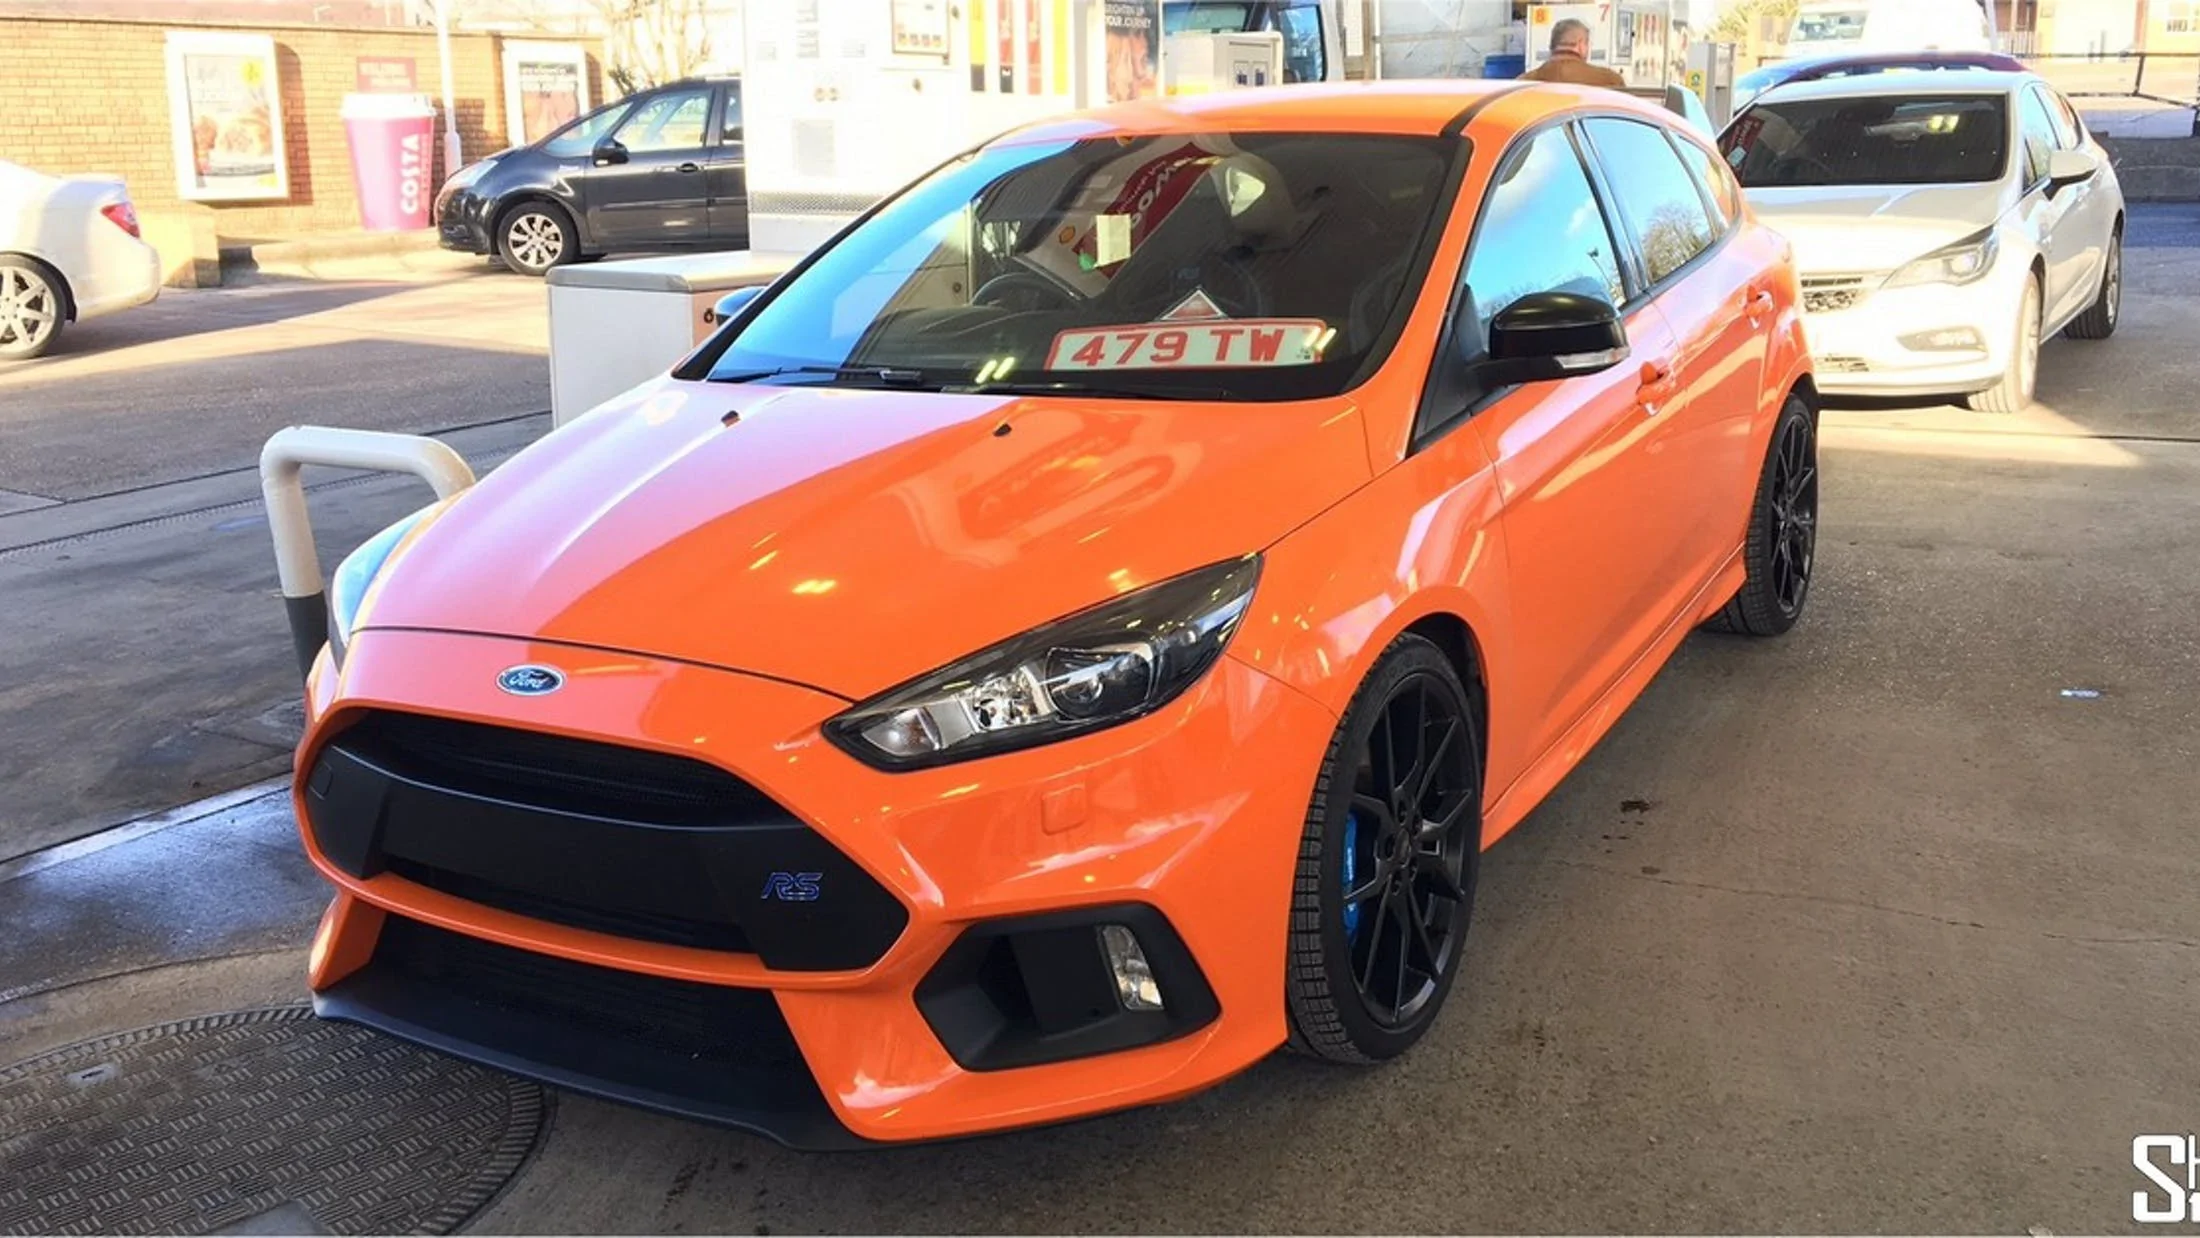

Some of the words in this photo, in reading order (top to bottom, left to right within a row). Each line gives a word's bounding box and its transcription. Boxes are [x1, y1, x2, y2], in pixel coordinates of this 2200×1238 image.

[1600, 4, 1611, 21] 7
[400, 133, 420, 215] COSTA
[1070, 331, 1189, 367] 479
[1209, 328, 1285, 362] TW
[508, 668, 550, 690] Ford
[761, 872, 823, 900] RS
